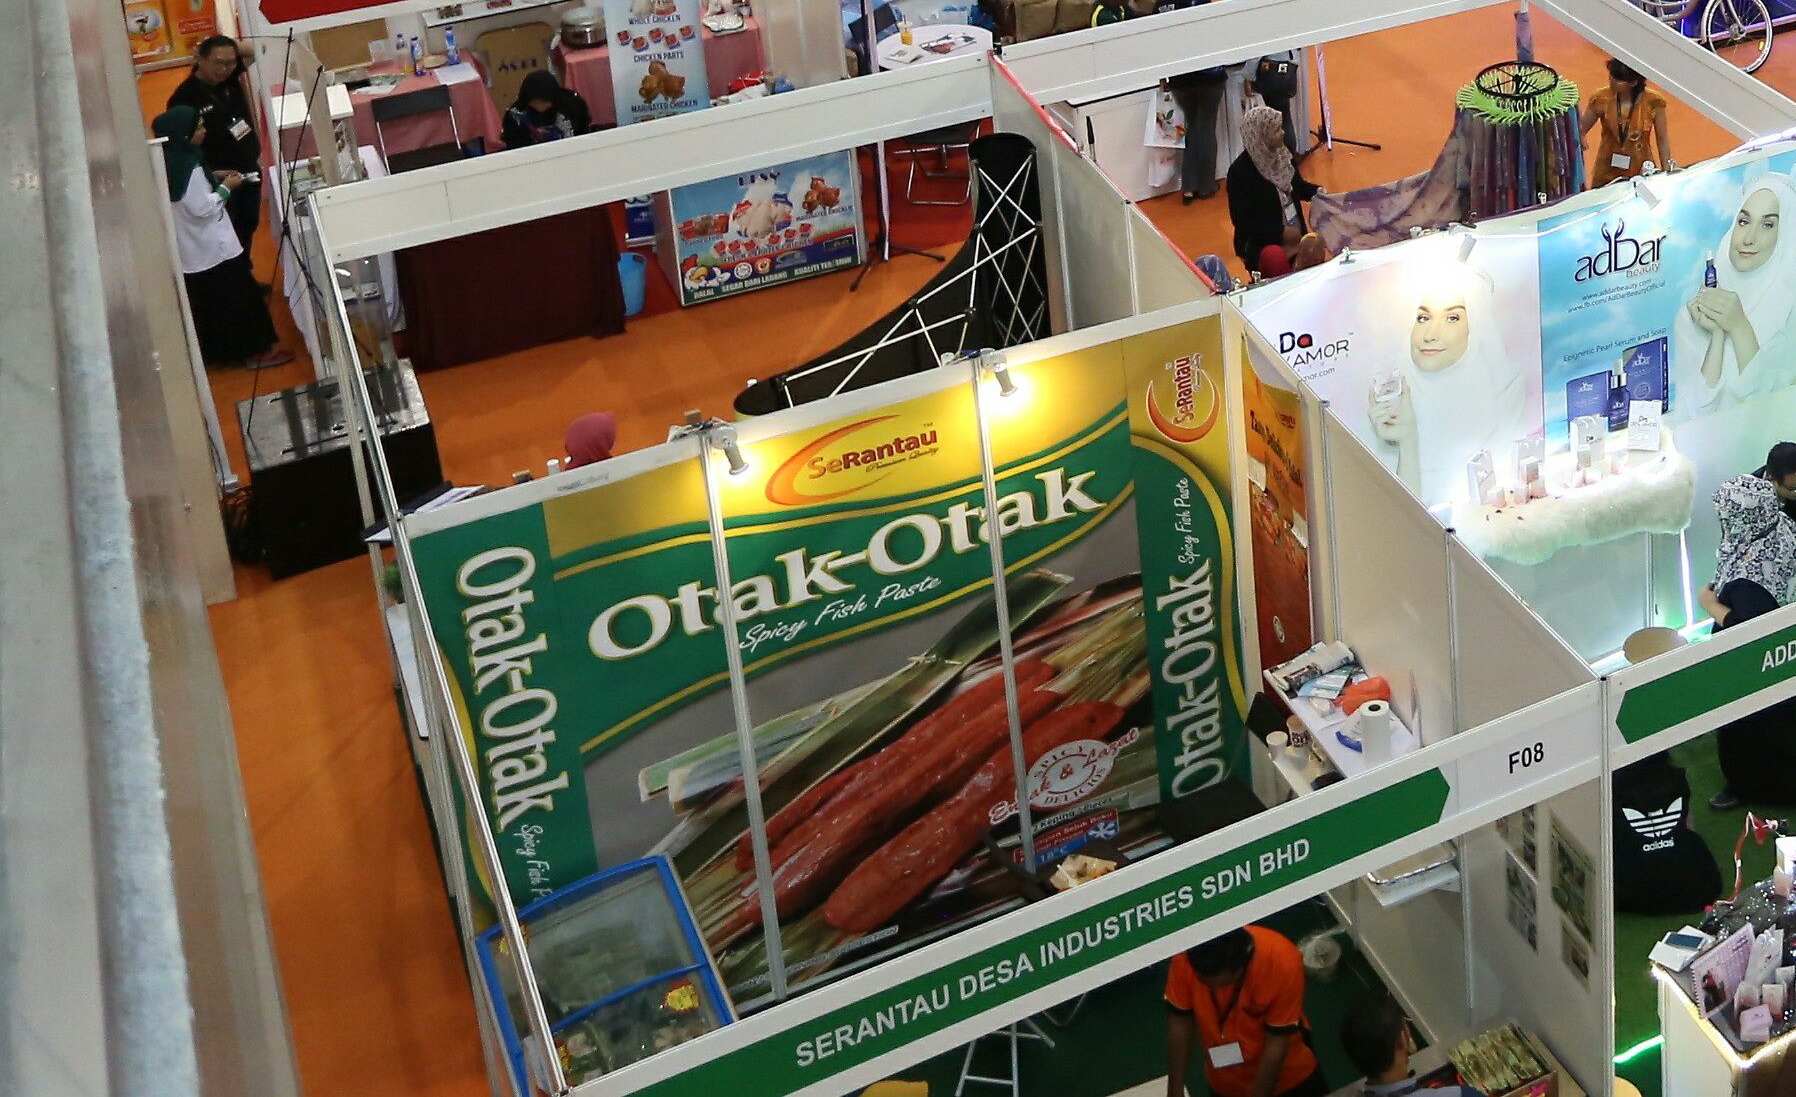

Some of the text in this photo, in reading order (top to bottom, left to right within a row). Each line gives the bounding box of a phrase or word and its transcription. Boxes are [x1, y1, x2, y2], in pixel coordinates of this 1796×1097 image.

[1625, 260, 1661, 279] beauty
[807, 423, 938, 481] SeRantau
[1173, 476, 1200, 565] Spicy Fish Paste
[588, 466, 1104, 660] Otak-Otak
[740, 575, 943, 654] Spicy Fish Paste
[457, 546, 570, 832] Otak-Otak
[1156, 559, 1223, 799] Otak-Otak
[1507, 740, 1545, 776] F08
[513, 824, 544, 857] Spicy
[1642, 838, 1675, 853] adidas
[795, 987, 953, 1067] SERANTAU
[955, 954, 1035, 1011] DESA
[1035, 885, 1195, 978] INDUSTRIES
[1199, 857, 1256, 909] SDN
[1259, 838, 1311, 882] BHD
